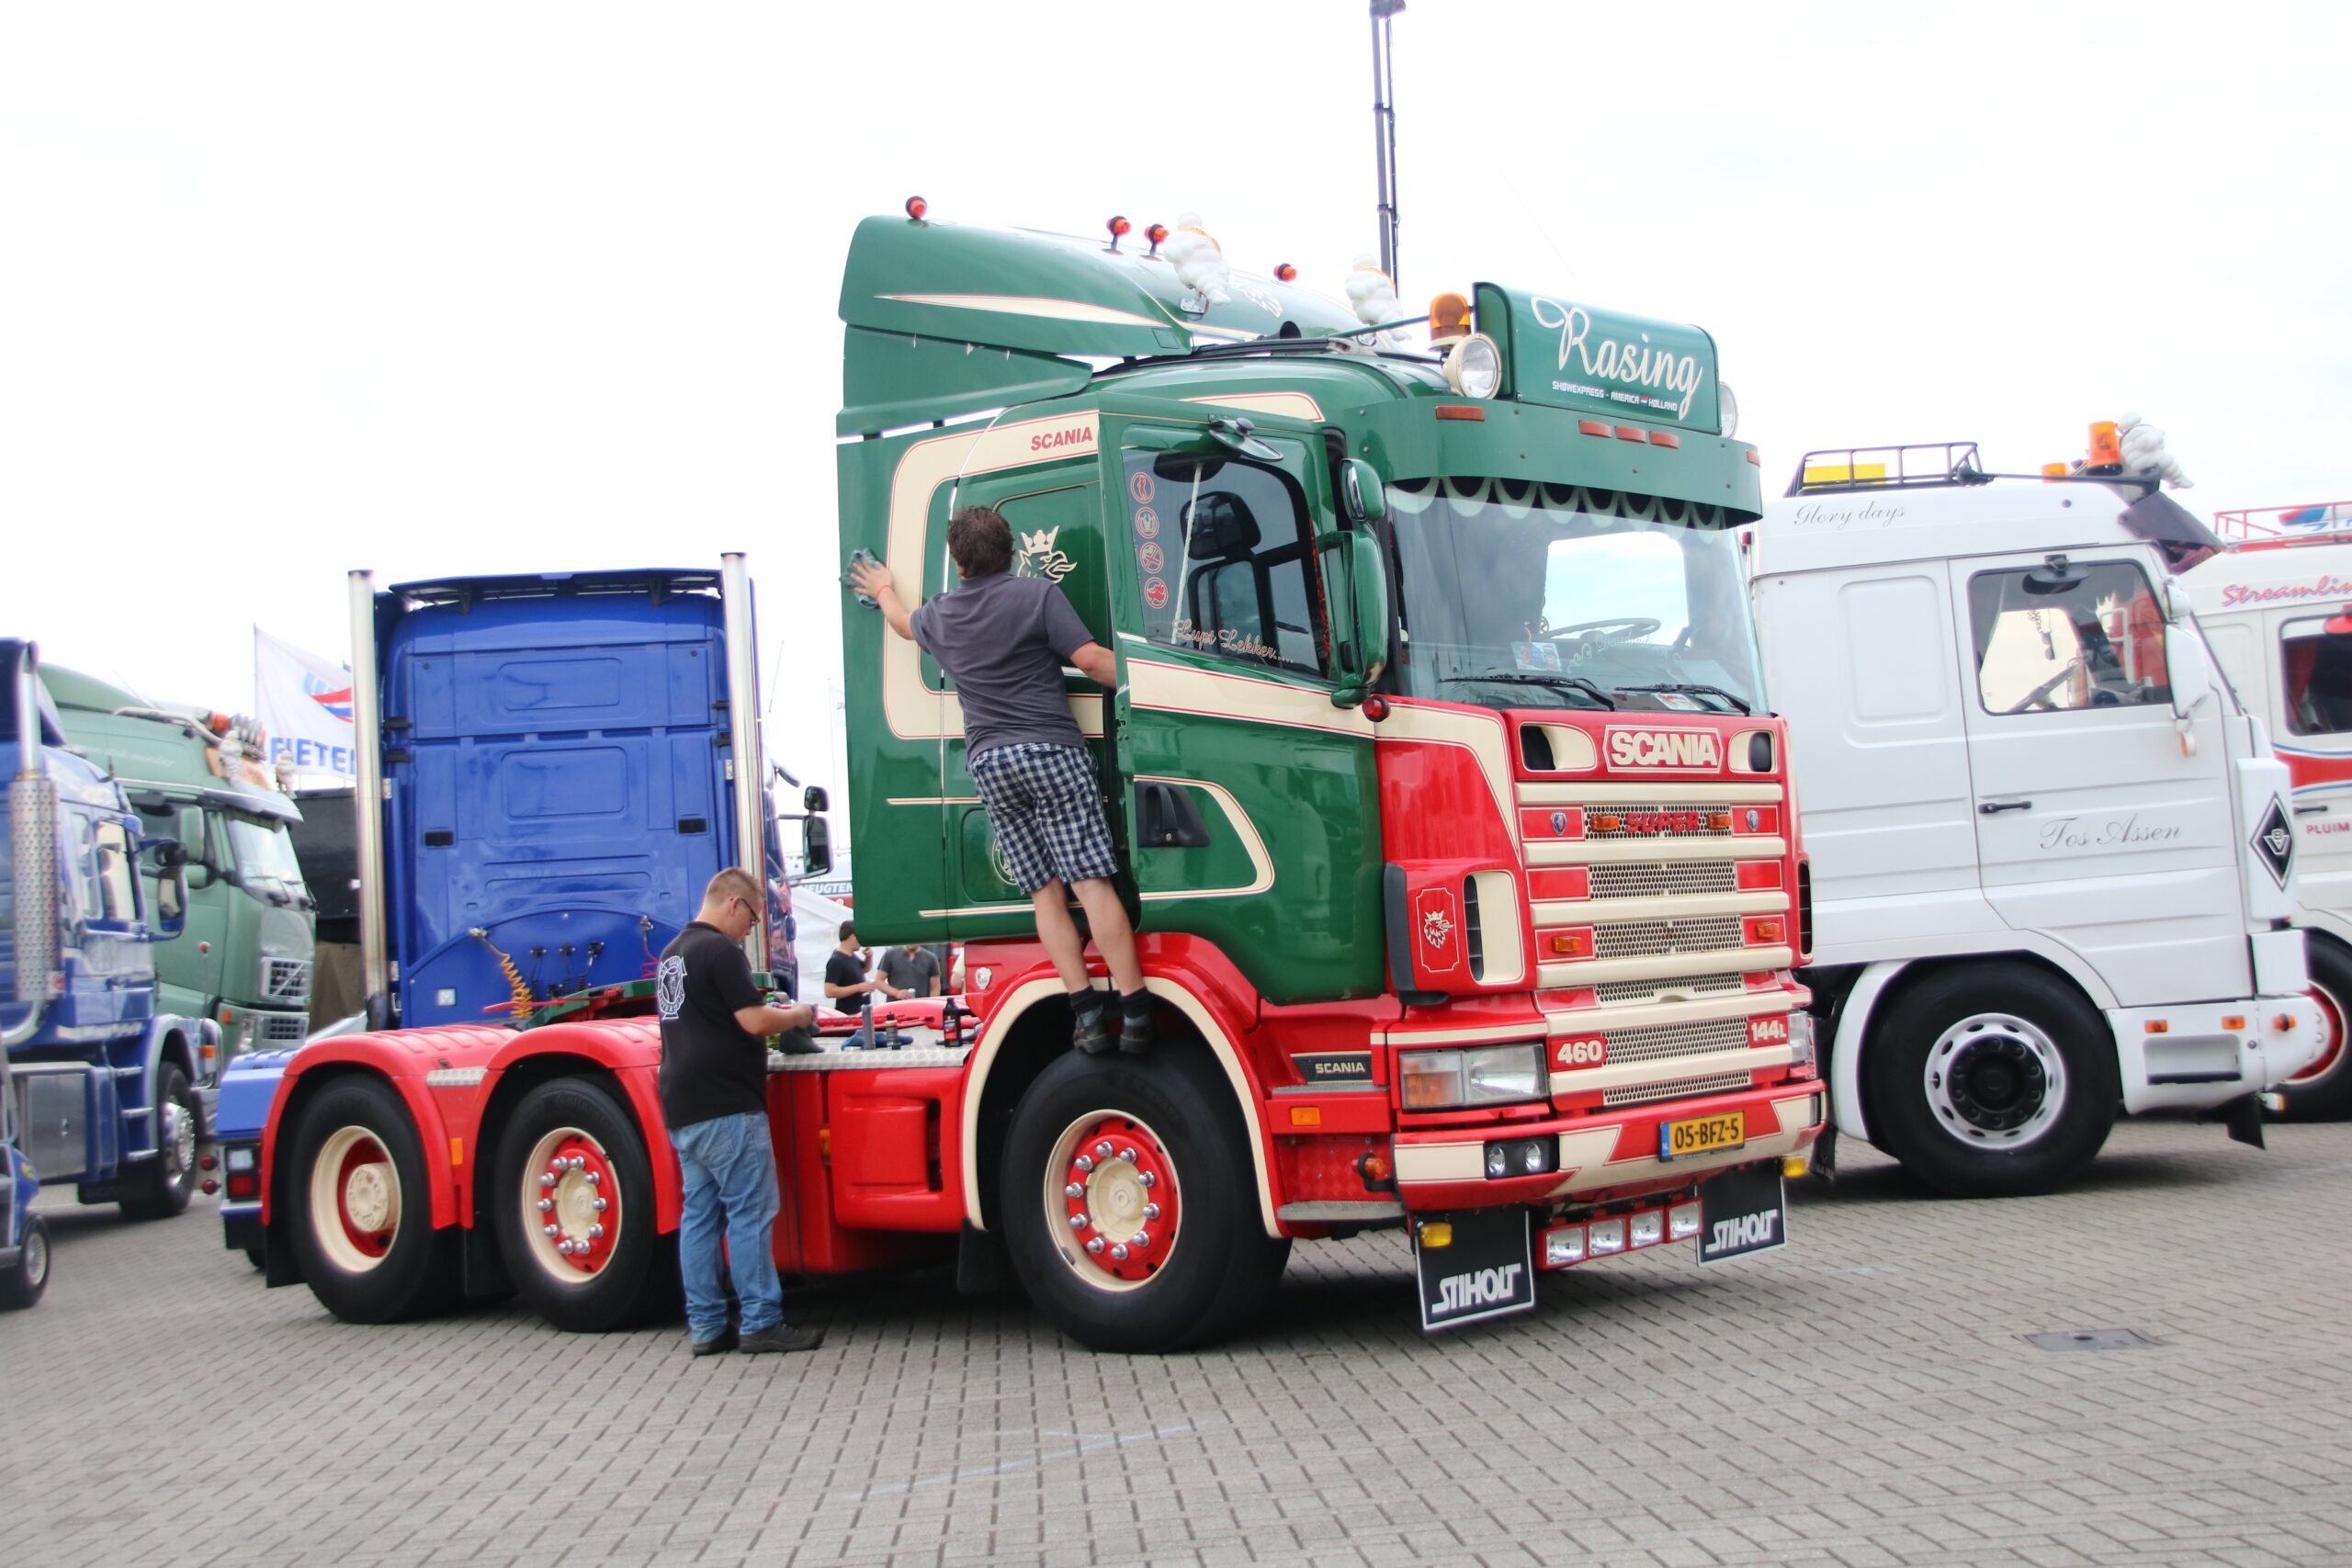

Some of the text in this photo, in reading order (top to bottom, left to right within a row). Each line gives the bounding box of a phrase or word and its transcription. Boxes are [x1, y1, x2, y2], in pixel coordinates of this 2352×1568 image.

[1531, 297, 1702, 421] Rasing
[1611, 391, 1640, 405] AMERICA
[1031, 426, 1093, 451] SCANIA
[1793, 501, 1905, 531] Glory days
[1611, 731, 1717, 766] SCANIA
[1624, 811, 1700, 833] SUPER
[2097, 812, 2181, 845] Assen
[1751, 1019, 1787, 1042] 144L
[1556, 1040, 1603, 1065] 460
[1315, 1062, 1366, 1074] SCANIA
[1674, 1117, 1739, 1150] 05-BFZ-5
[1705, 1208, 1778, 1254] STIHOLT
[1431, 1262, 1521, 1314] STIHOLT
